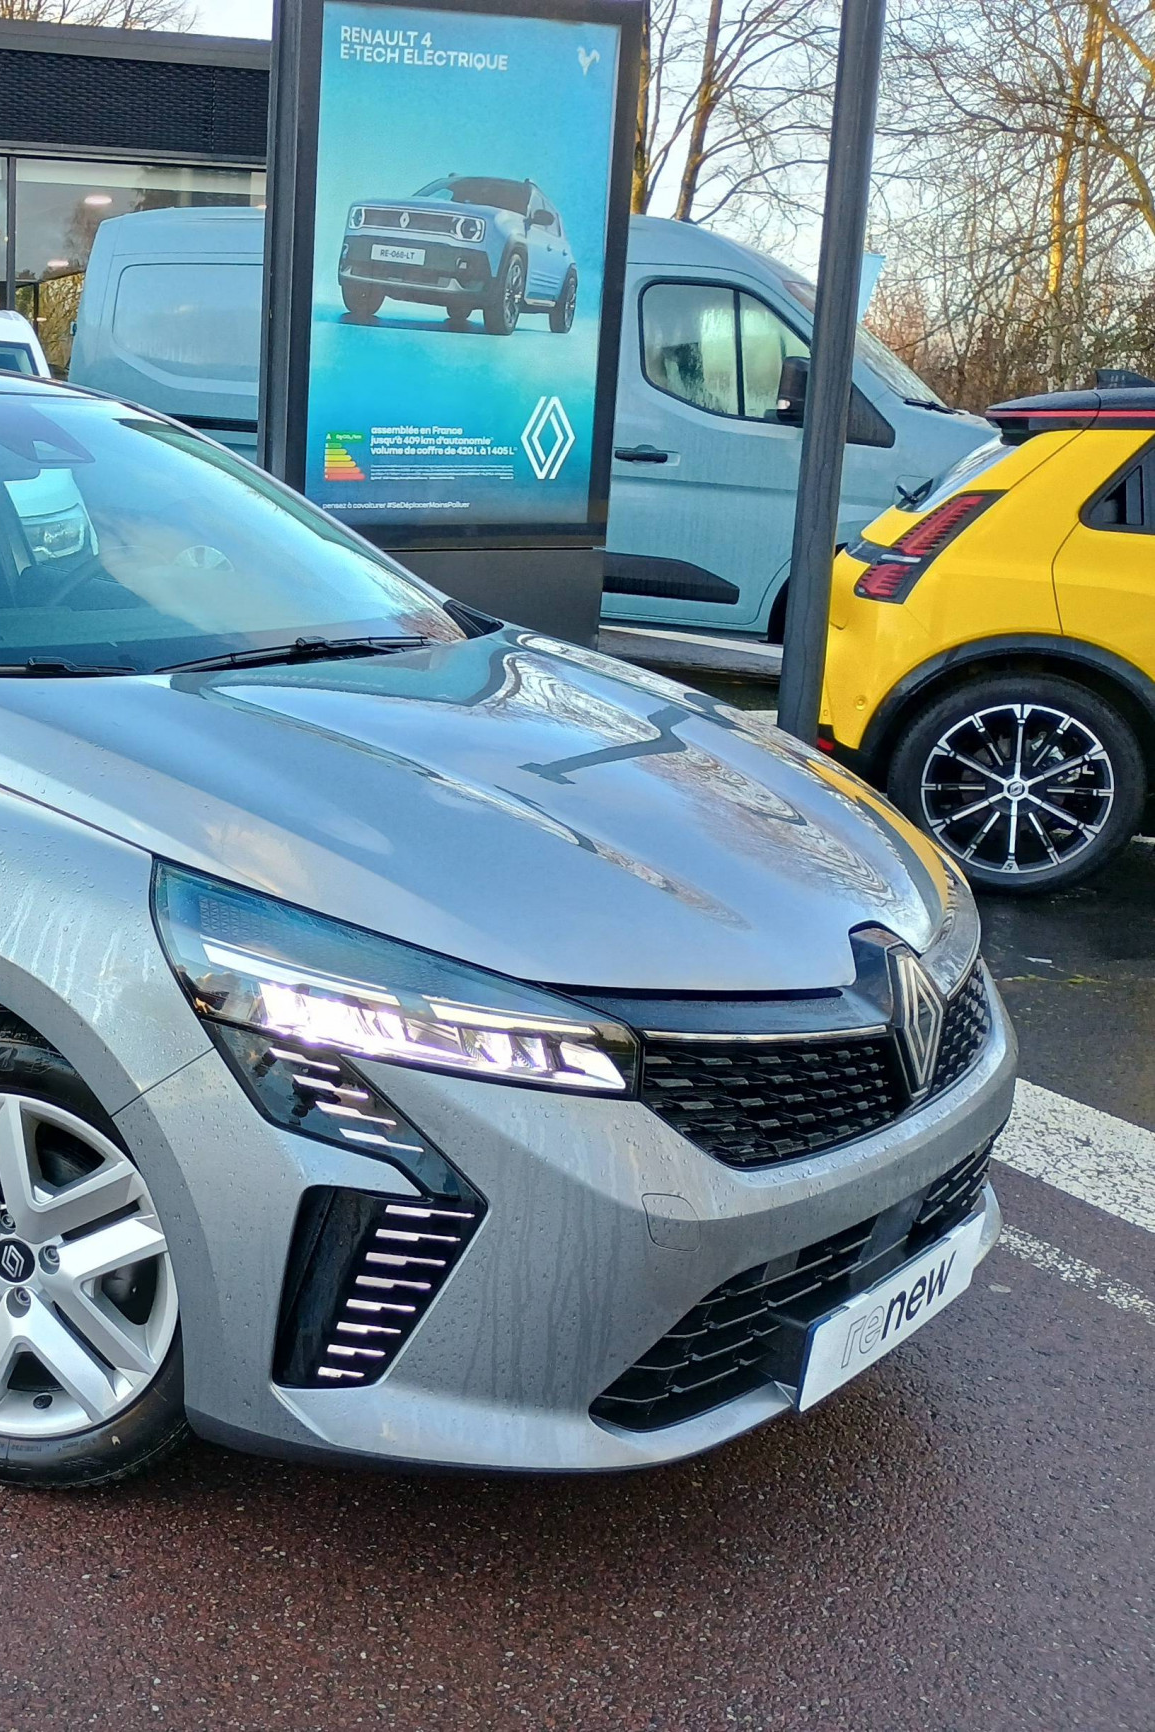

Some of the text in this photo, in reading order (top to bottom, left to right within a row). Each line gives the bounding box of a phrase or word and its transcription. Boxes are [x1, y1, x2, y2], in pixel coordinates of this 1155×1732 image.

[340, 25, 433, 48] RENAULT 4
[340, 43, 509, 71] E-TECH ELECTRIQUE
[420, 427, 431, 435] en
[432, 426, 463, 435] France
[403, 436, 420, 445] 409
[420, 436, 435, 445] km
[371, 446, 403, 455] volume
[404, 446, 416, 455] de
[416, 446, 443, 455] coffre
[444, 446, 456, 455] de
[457, 446, 473, 455] 420
[841, 1249, 958, 1370] renew
